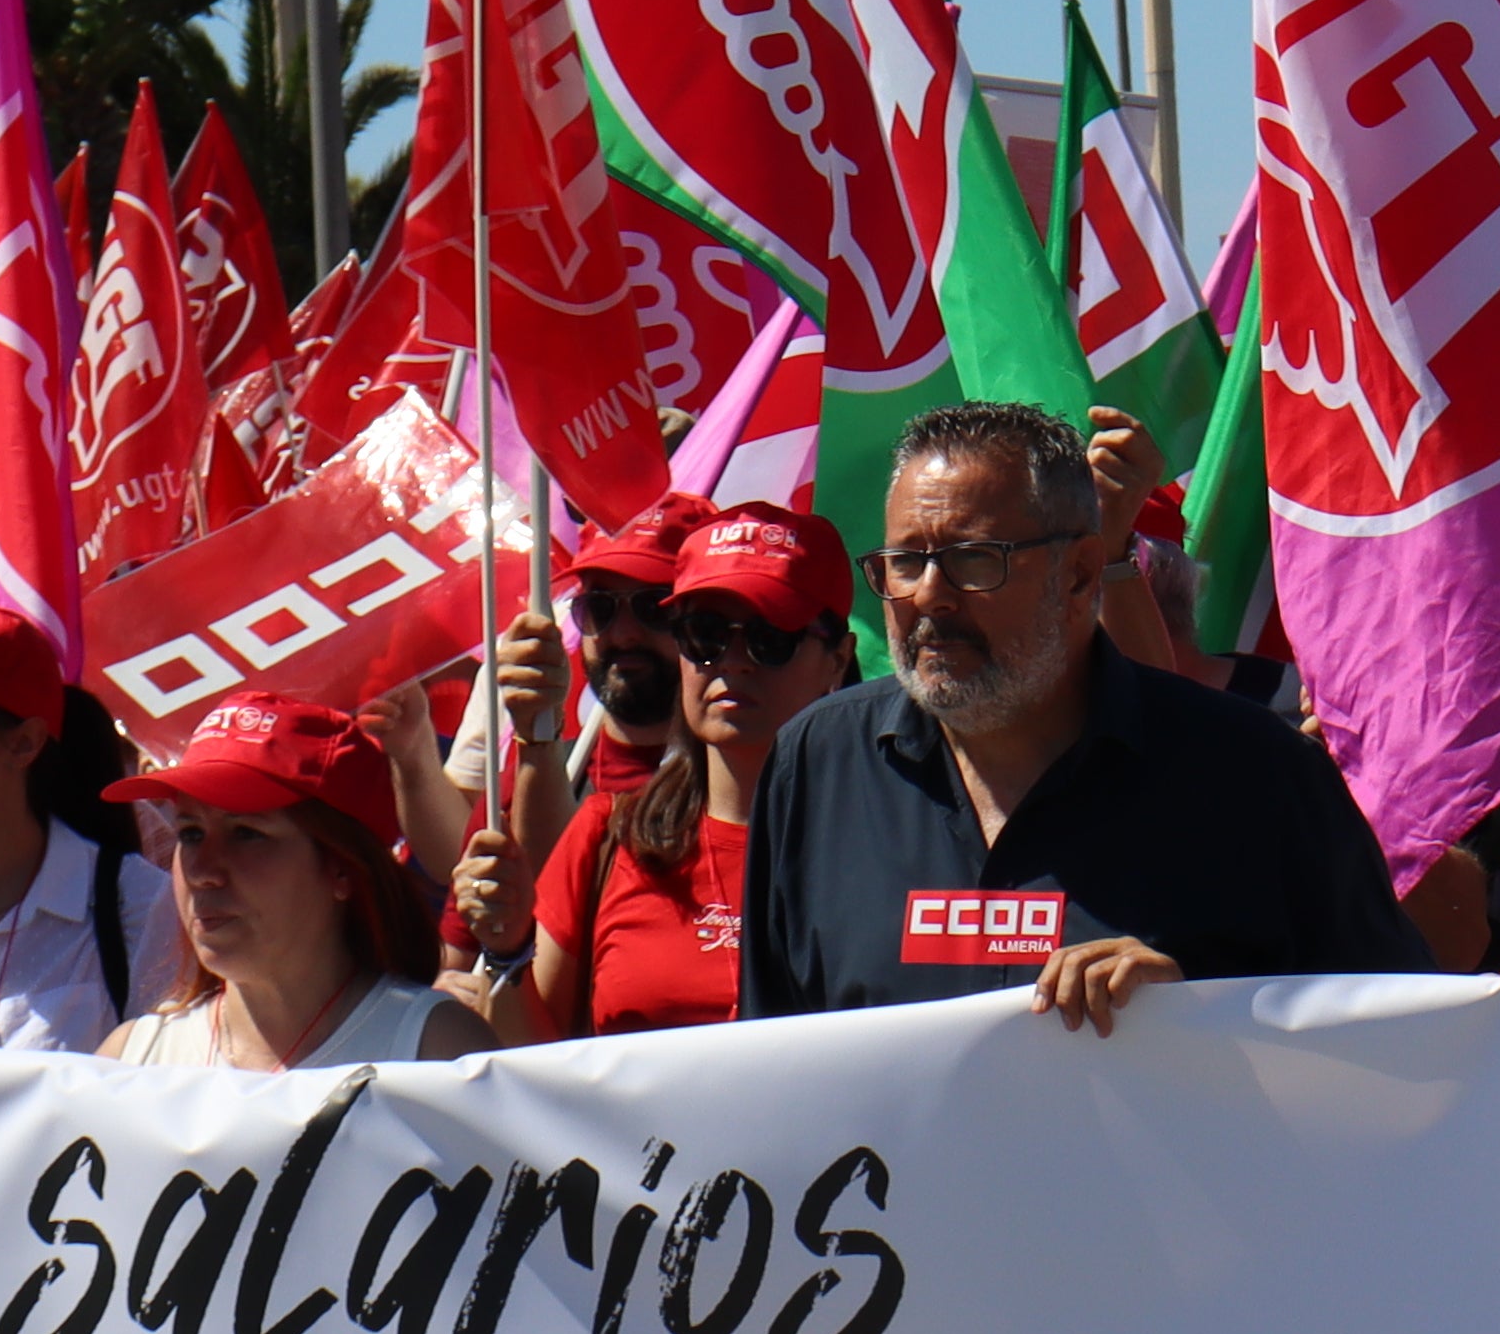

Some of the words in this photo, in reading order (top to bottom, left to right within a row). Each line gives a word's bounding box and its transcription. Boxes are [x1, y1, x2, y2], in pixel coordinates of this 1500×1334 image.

[709, 522, 761, 545] UGT
[909, 898, 1059, 936] CCOO
[987, 937, 1053, 953] ALMERÍA
